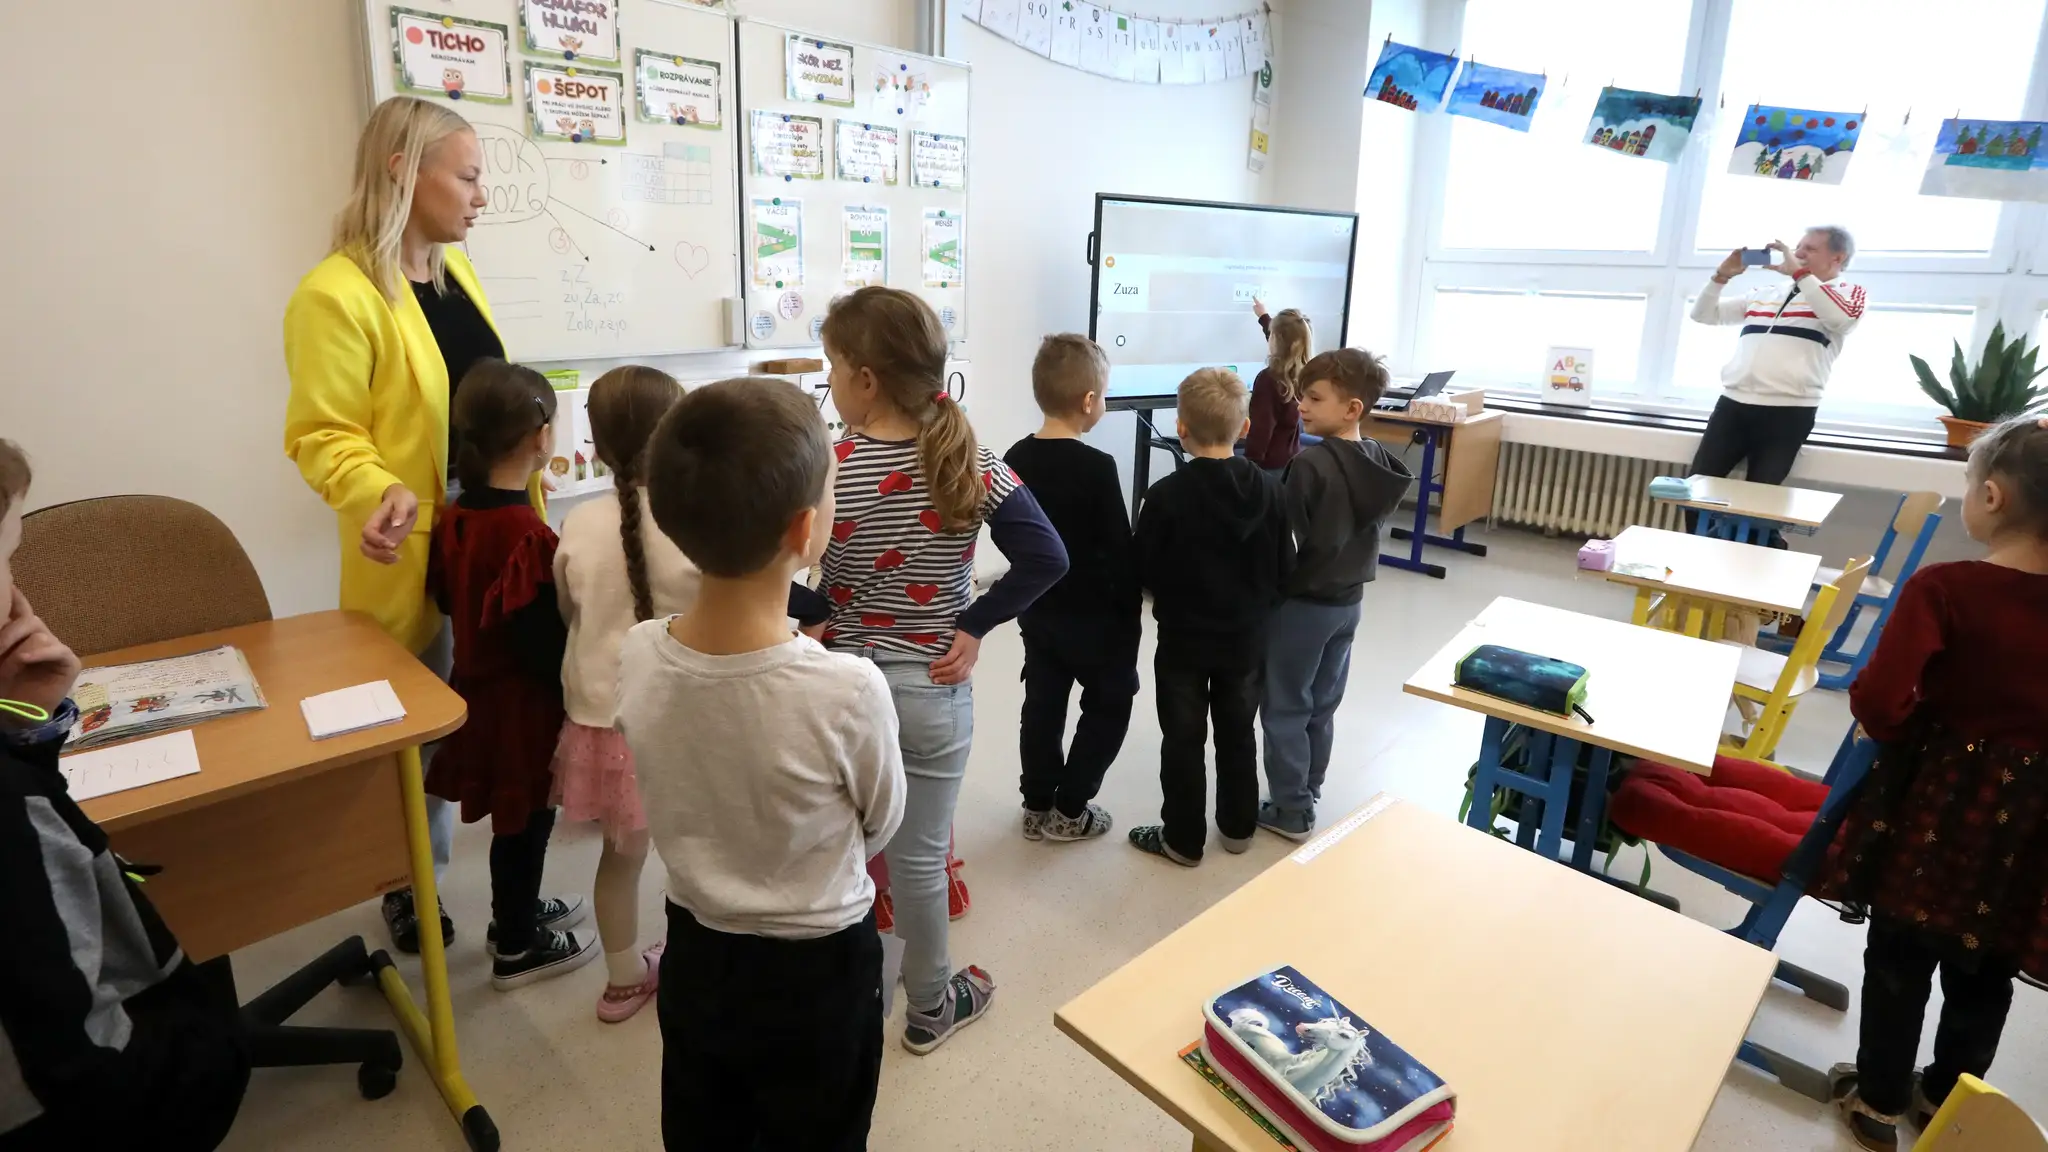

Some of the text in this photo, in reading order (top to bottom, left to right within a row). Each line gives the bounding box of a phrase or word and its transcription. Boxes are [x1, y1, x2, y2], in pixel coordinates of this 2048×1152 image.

[1038, 4, 1047, 19] Q
[541, 11, 598, 36] HLUKU
[1069, 18, 1076, 30] R
[426, 29, 485, 53] TICHO
[659, 71, 712, 87] ROZPRÁVANIE
[554, 77, 608, 102] ŠEPOT
[476, 137, 536, 174] TOK
[1113, 283, 1139, 296] Zuza
